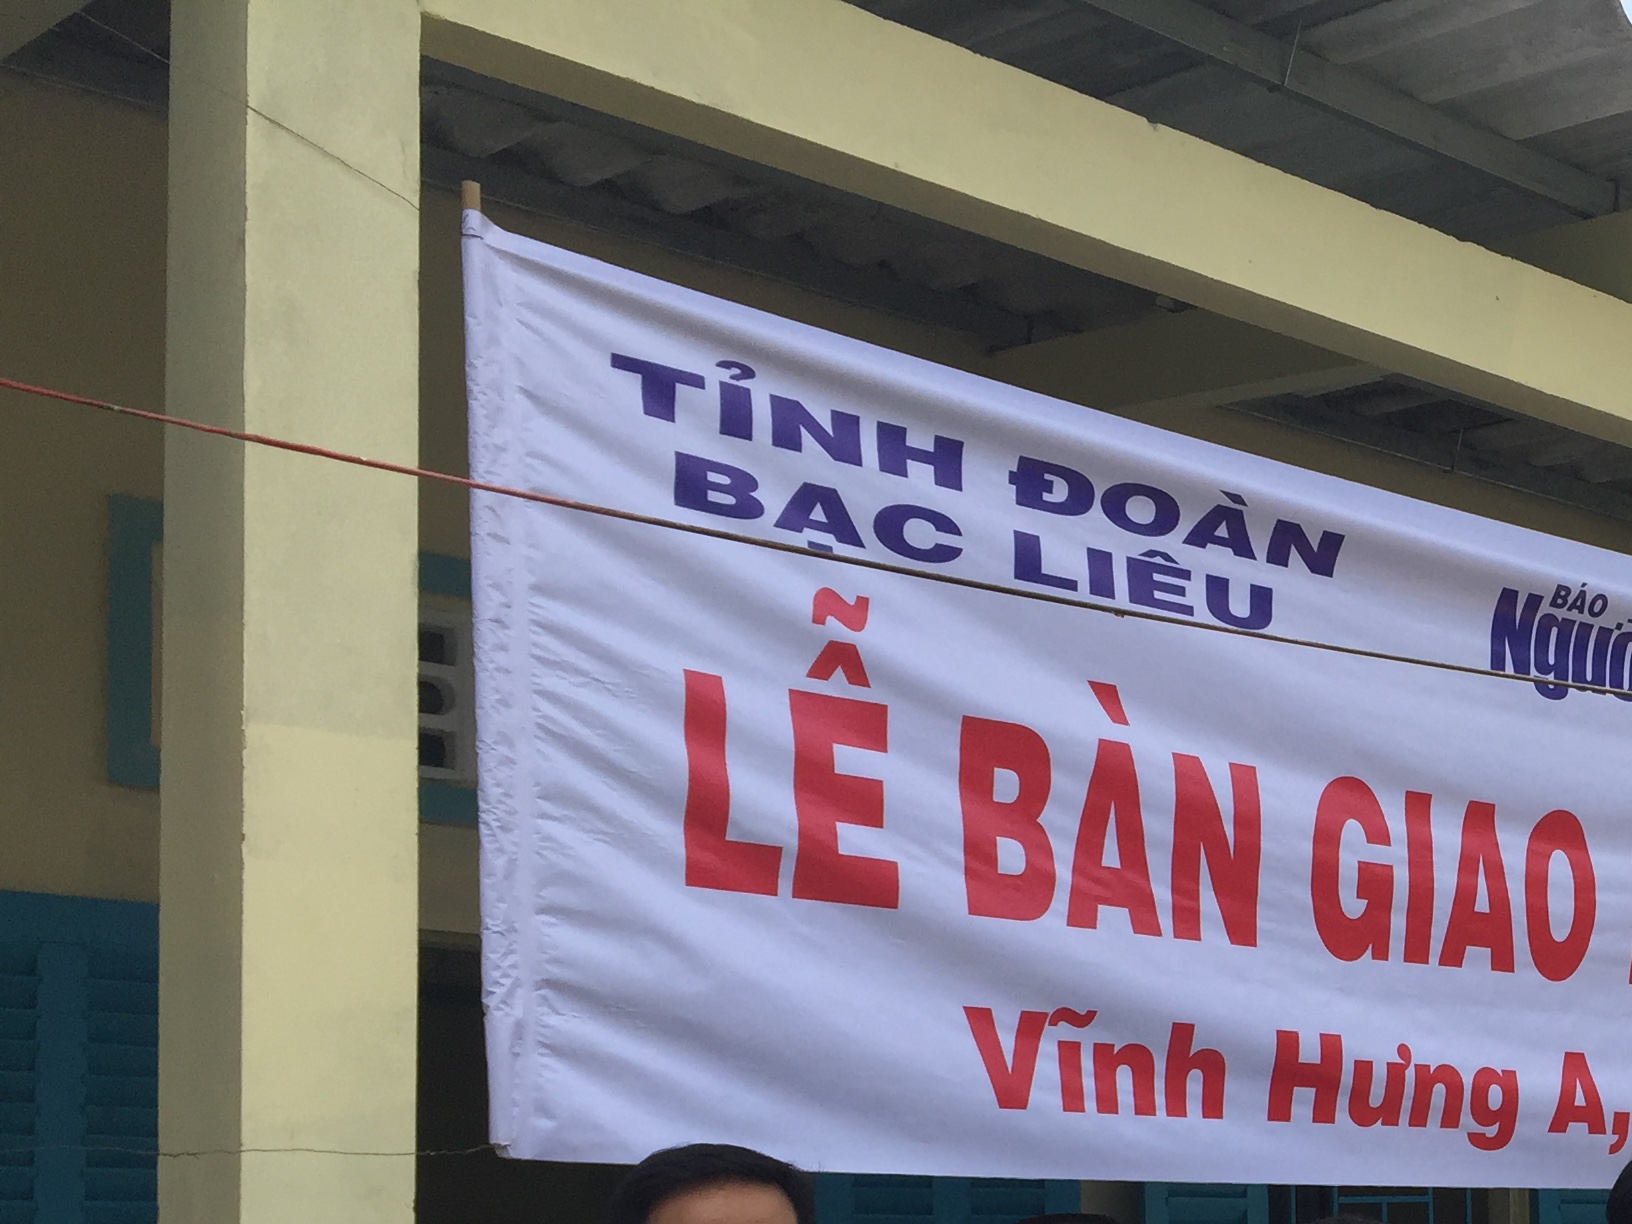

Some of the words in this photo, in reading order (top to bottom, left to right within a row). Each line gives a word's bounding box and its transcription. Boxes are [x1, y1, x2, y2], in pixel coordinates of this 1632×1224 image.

[610, 352, 964, 492] TỈNH
[1007, 455, 1346, 578] ĐOÀN
[672, 451, 965, 565] BẠC
[1012, 531, 1274, 631] LIÊU
[1549, 582, 1609, 619] BÁO
[683, 586, 900, 909] LỄ
[959, 680, 1262, 948] BÀN
[1311, 775, 1596, 983] GIAO
[962, 1005, 1226, 1120] Vĩnh
[1267, 1029, 1519, 1151] Hưng
[1548, 1051, 1631, 1155] A,
